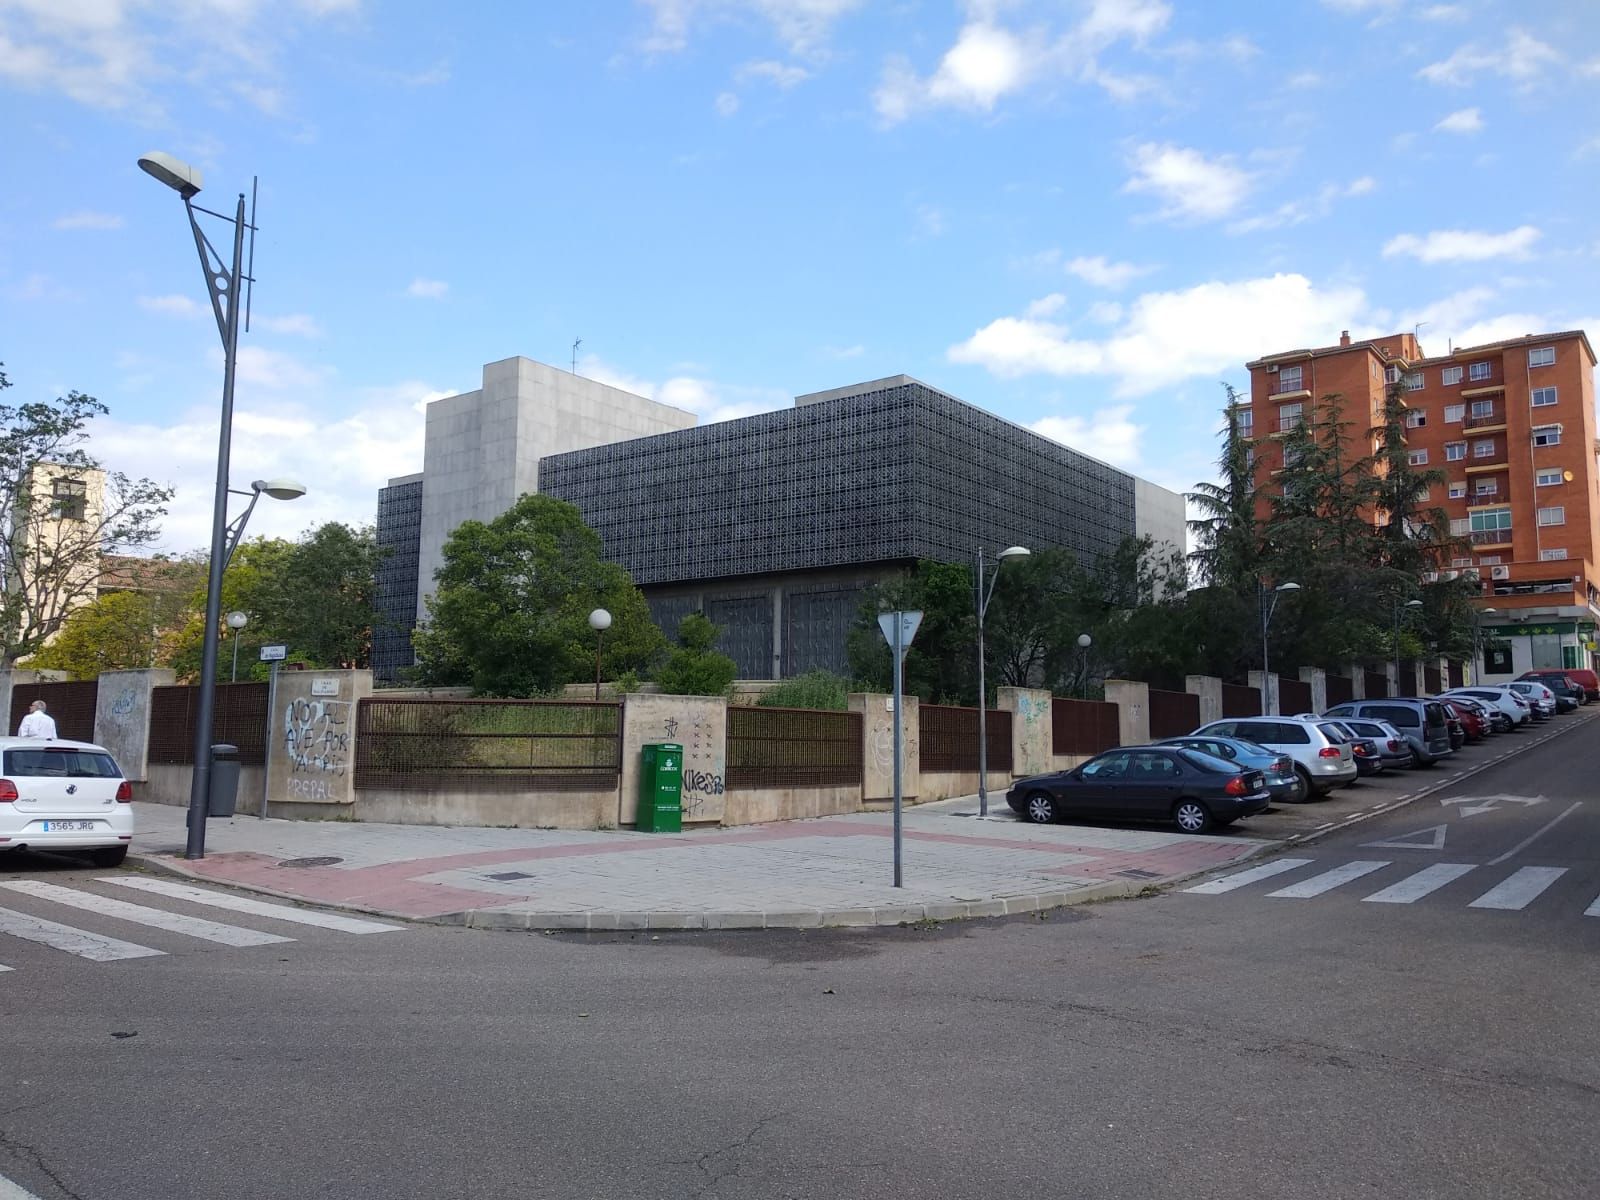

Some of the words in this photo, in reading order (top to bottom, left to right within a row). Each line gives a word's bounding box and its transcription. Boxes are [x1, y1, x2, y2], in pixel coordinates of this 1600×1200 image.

[290, 701, 310, 722] NO
[284, 728, 314, 750] AVE
[324, 730, 348, 751] POR
[50, 822, 74, 831] 3565
[77, 822, 94, 831] JRG
